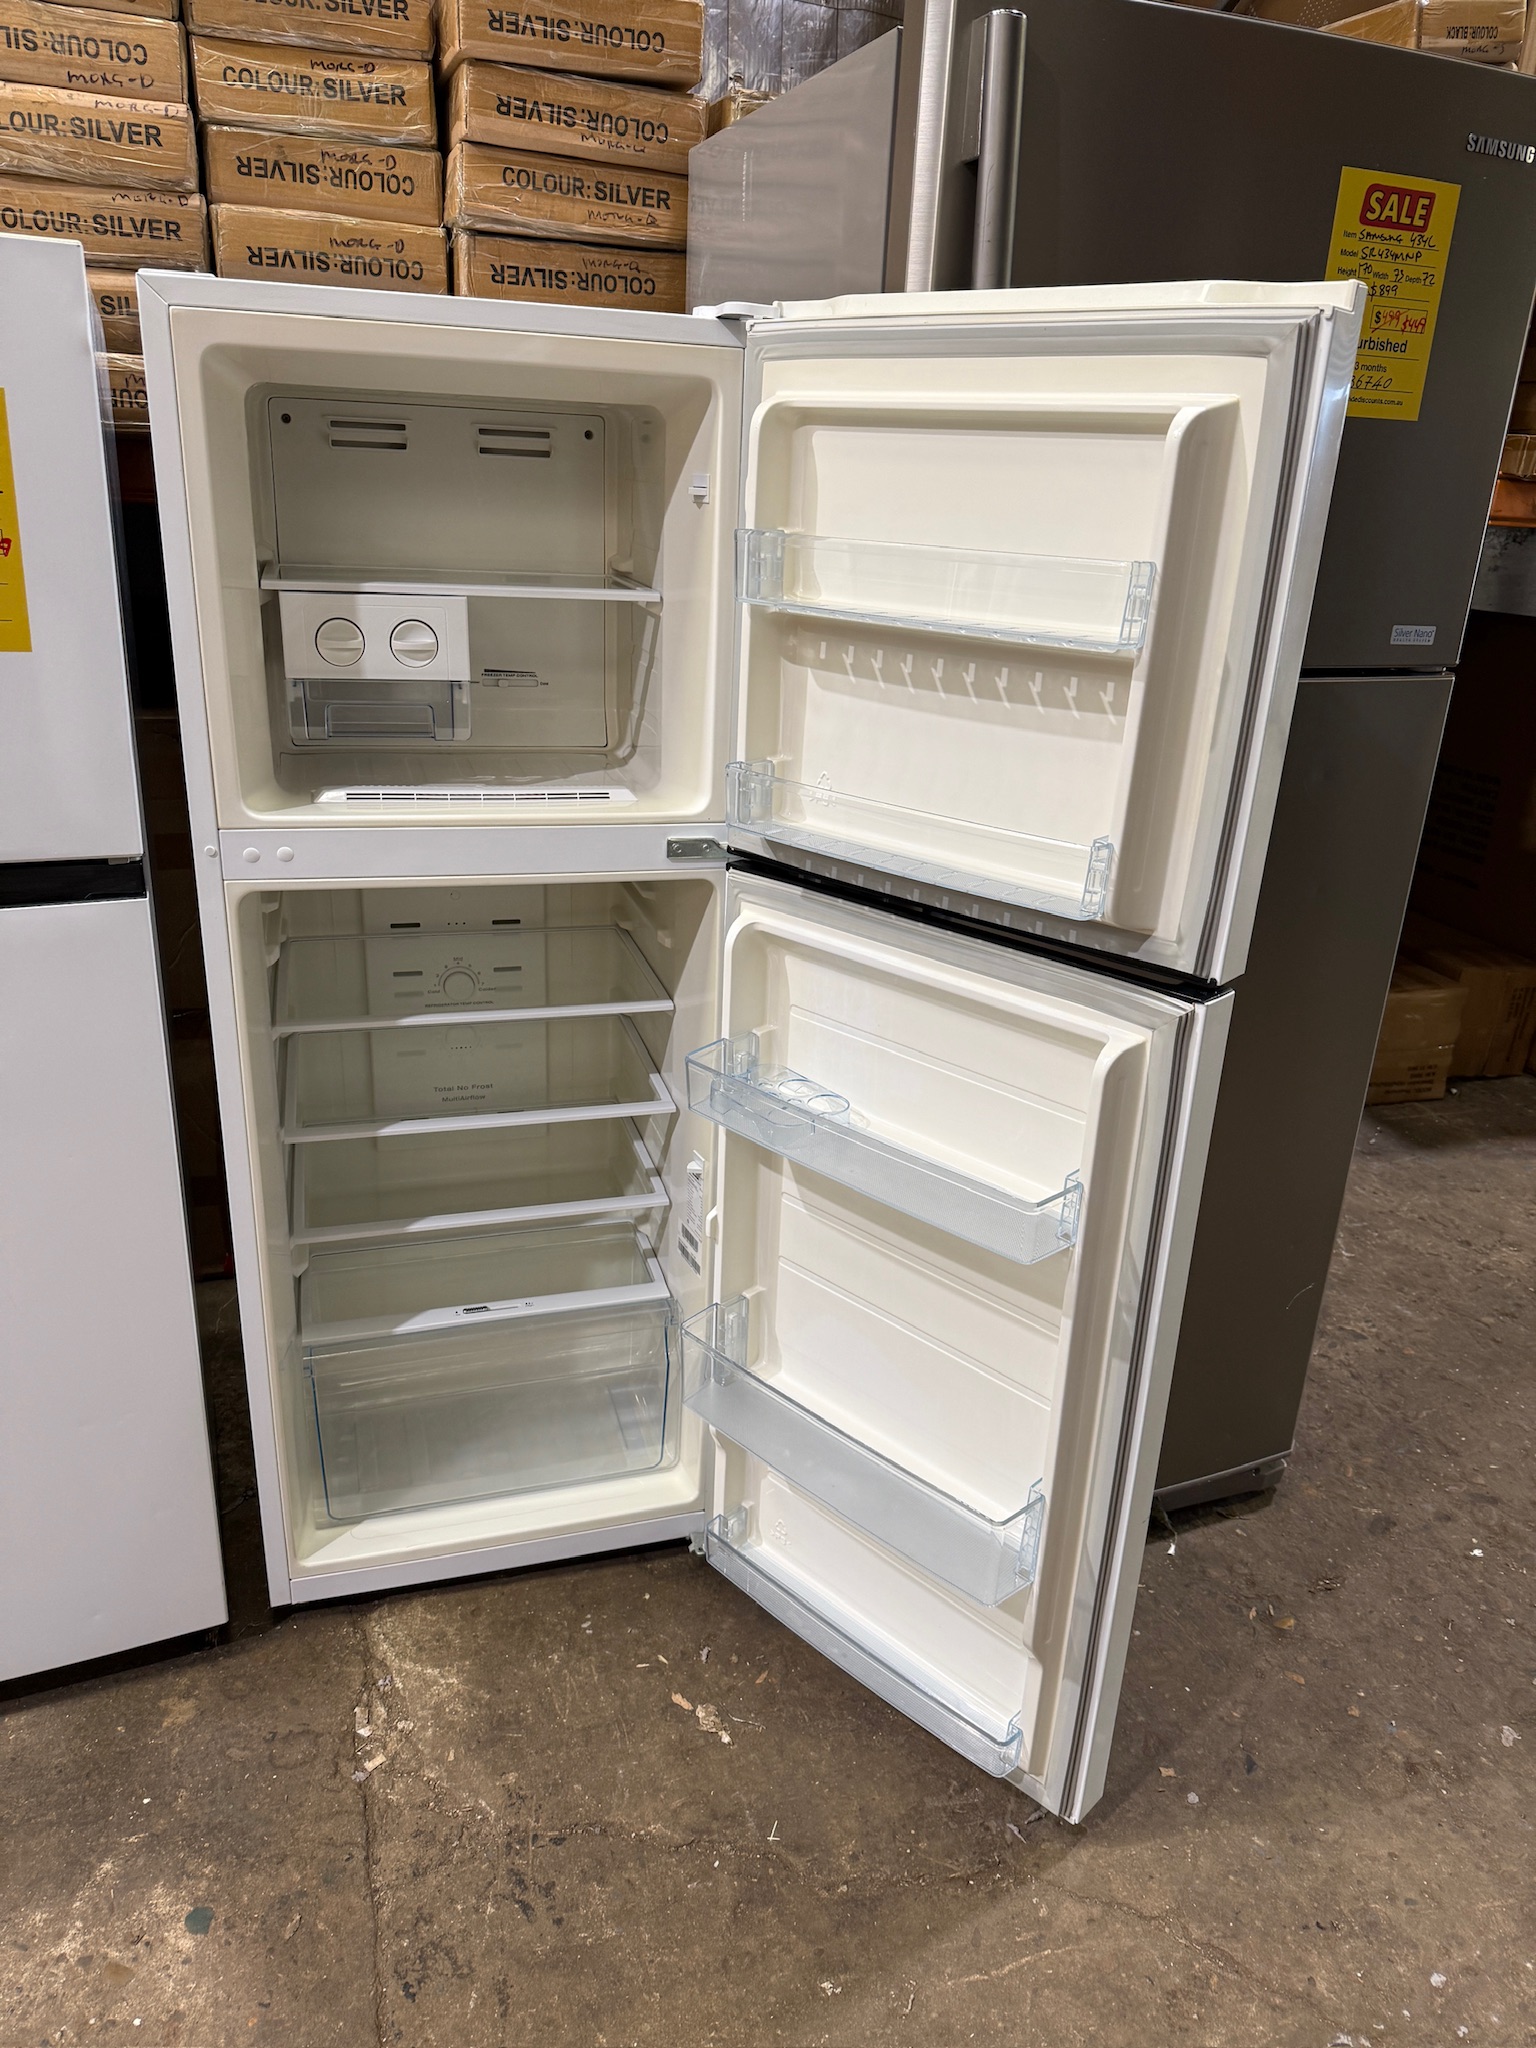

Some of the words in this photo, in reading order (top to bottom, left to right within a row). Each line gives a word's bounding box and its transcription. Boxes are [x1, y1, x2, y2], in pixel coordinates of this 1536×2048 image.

[1466, 132, 1536, 164] SAMSUNG
[1365, 190, 1431, 227] SALE
[1343, 230, 1357, 239] Item
[1340, 248, 1358, 257] Model
[1337, 266, 1357, 277] Height
[1372, 272, 1389, 280] Width
[1405, 275, 1421, 284] Depth
[1360, 363, 1388, 373] months
[1394, 627, 1413, 638] Silver
